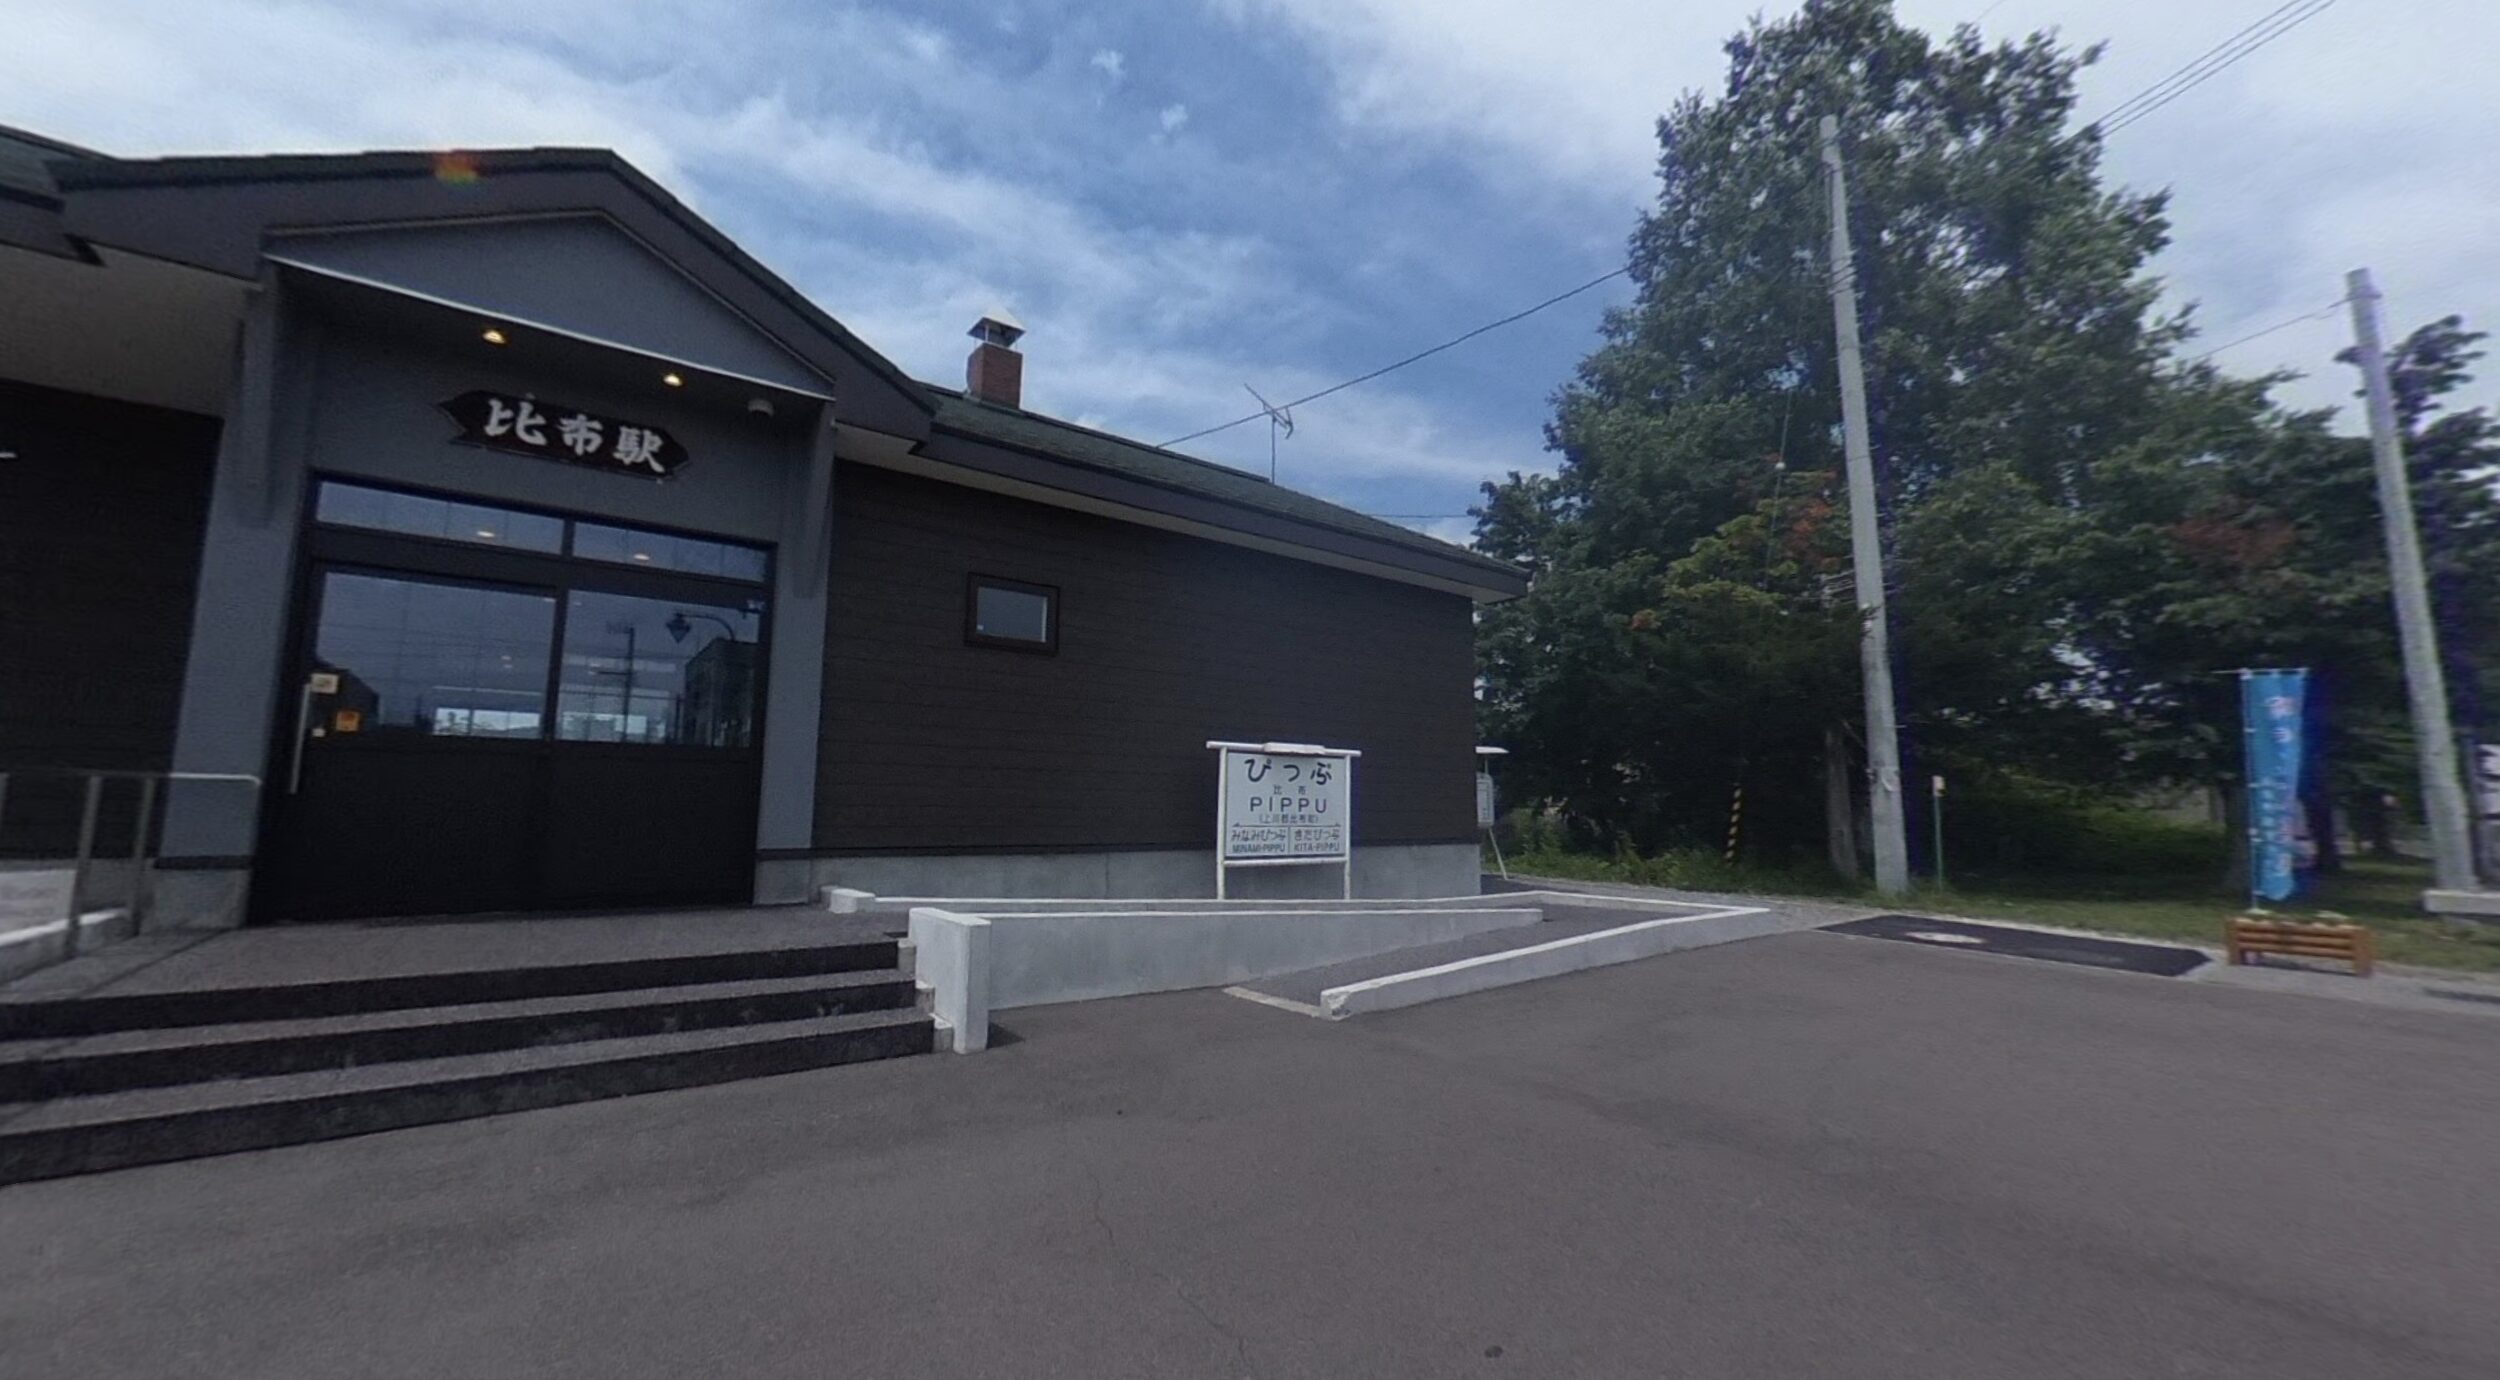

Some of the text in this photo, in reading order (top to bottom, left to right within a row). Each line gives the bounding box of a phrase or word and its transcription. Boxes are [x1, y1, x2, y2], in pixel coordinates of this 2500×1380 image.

[484, 399, 665, 473] 比布駅
[1250, 797, 1327, 814] PIPPU
